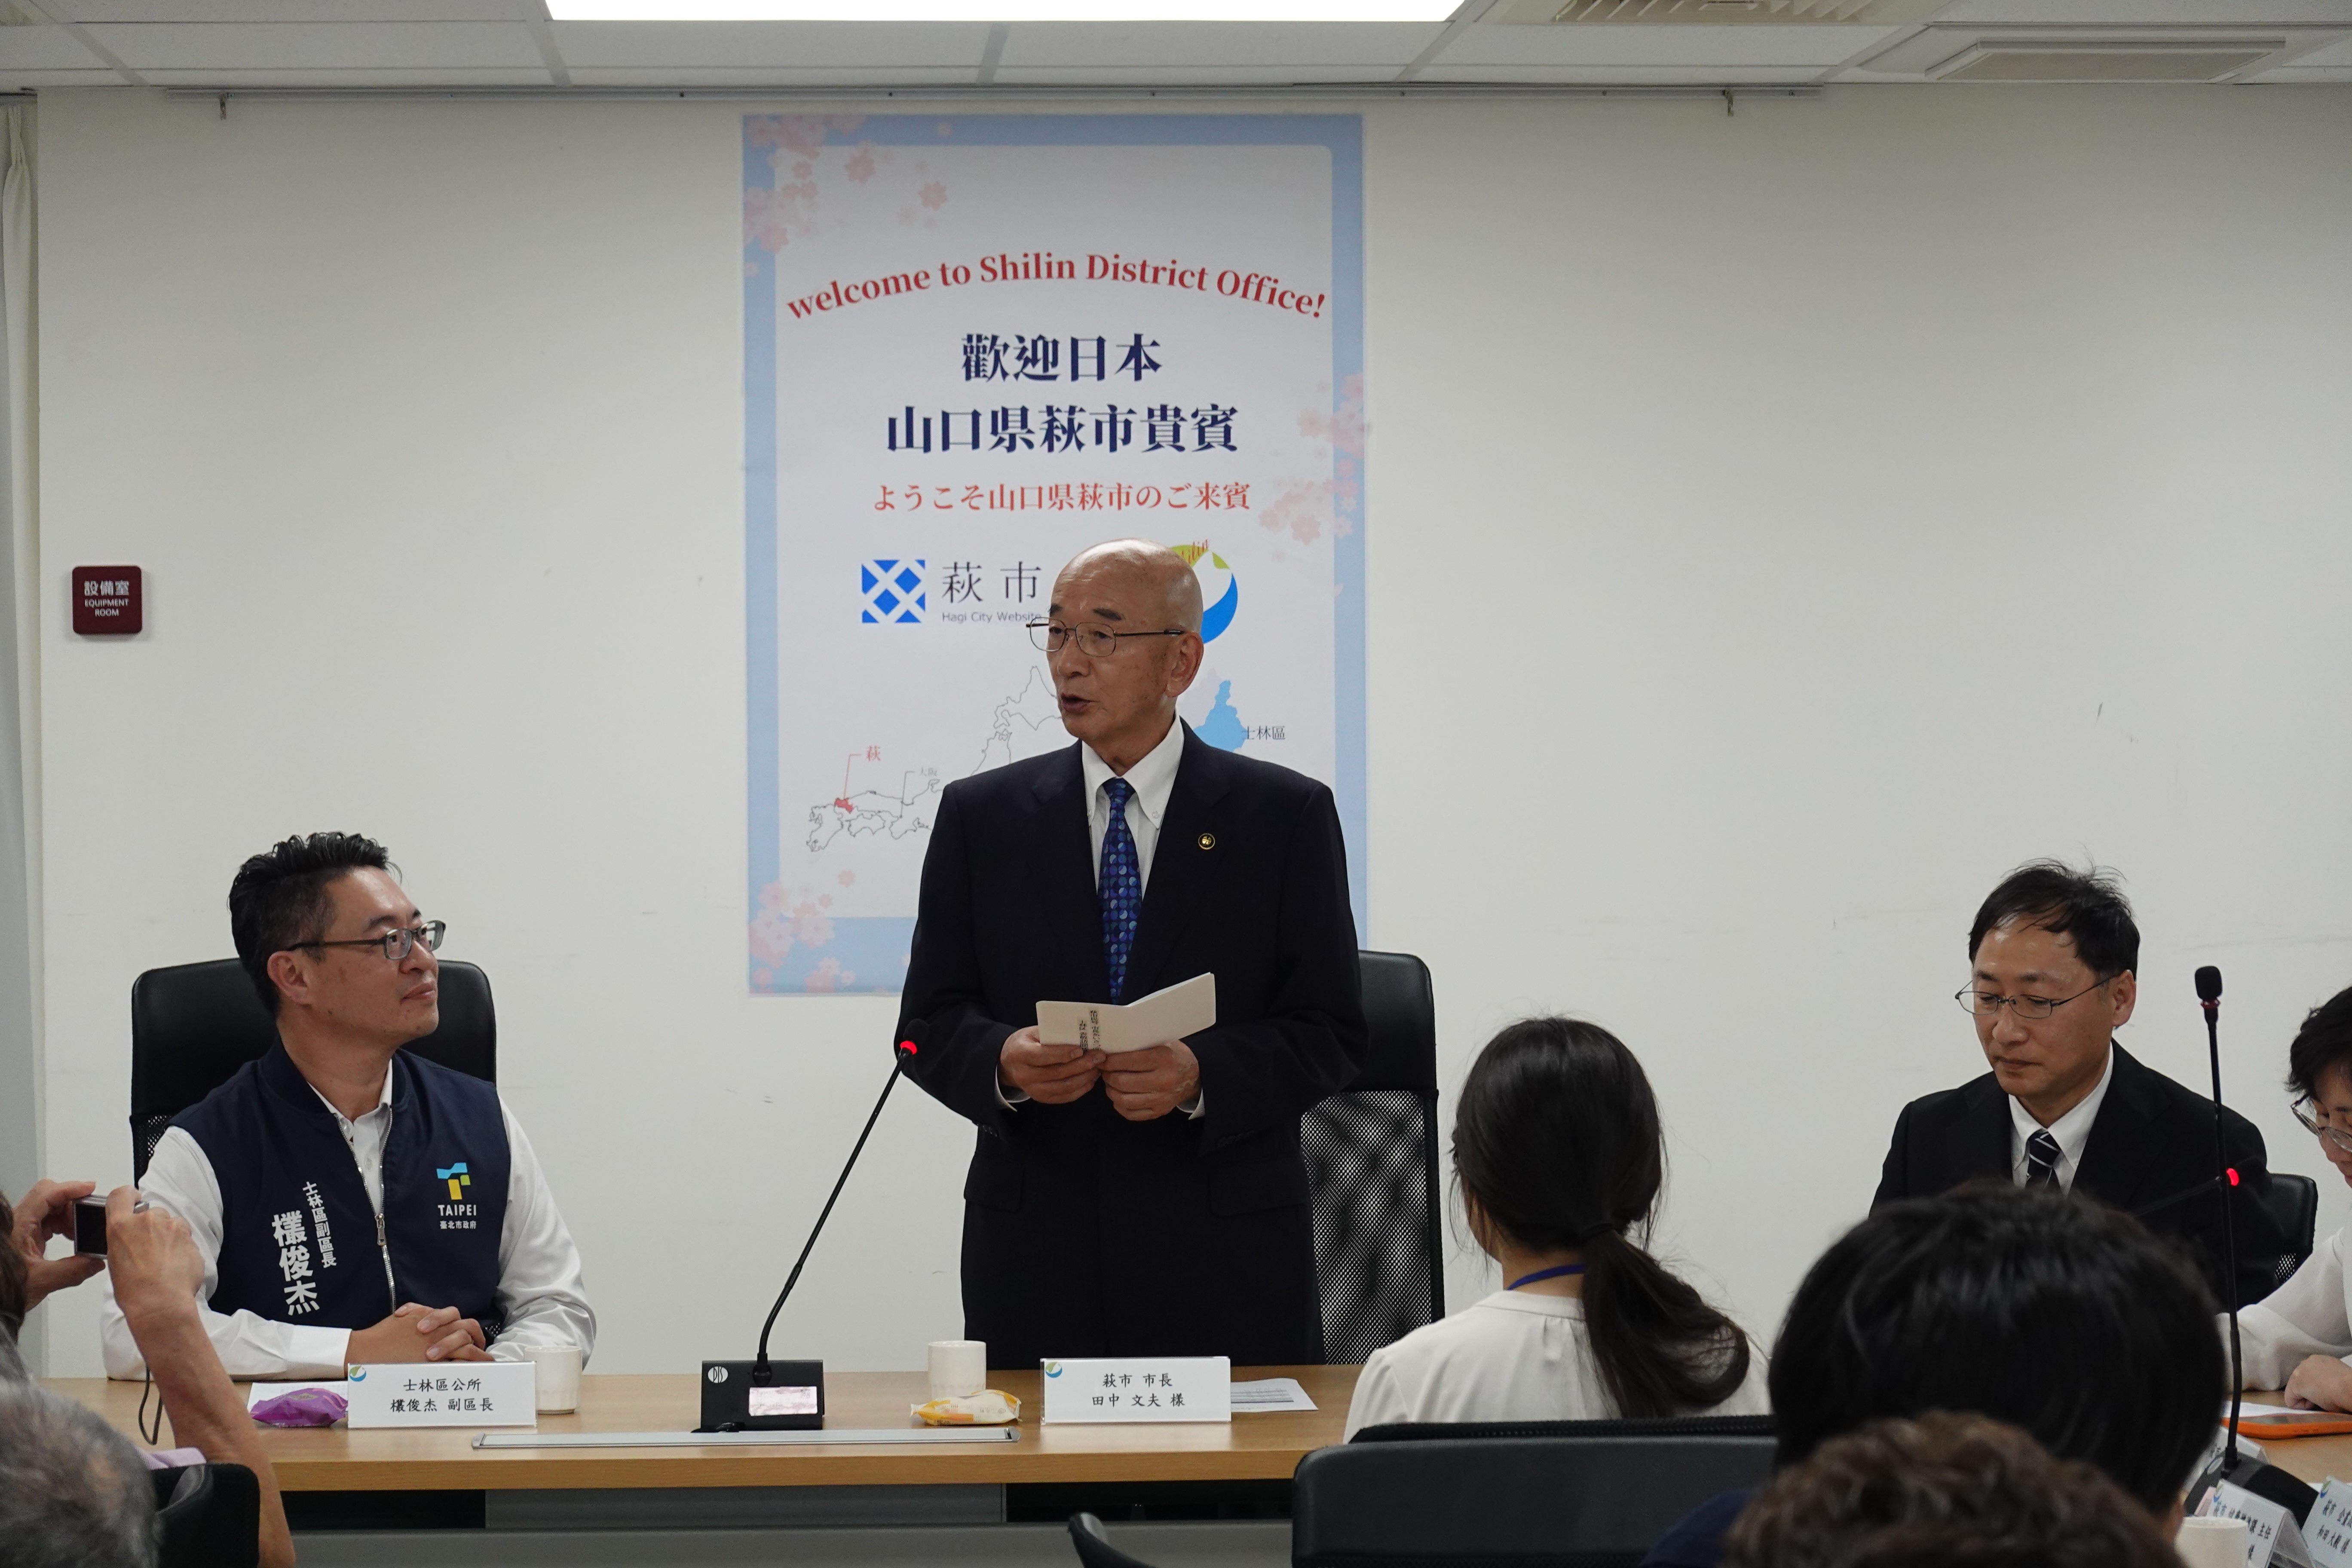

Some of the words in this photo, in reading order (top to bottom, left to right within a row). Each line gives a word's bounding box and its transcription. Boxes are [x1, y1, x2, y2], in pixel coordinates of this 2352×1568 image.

[787, 270, 931, 319] welcome
[940, 263, 971, 286] to
[980, 252, 1076, 282] Shilin
[1087, 254, 1208, 291] District
[1216, 270, 1325, 318] Office!
[962, 333, 1162, 382] 歡迎日本
[887, 403, 1238, 453] 山口県萩市貴賓
[874, 481, 1250, 511] ようこそ山口県萩市のご来賓
[84, 580, 129, 596] 設備室
[84, 598, 129, 608] EQUIPMENT
[95, 608, 119, 617] ROOM
[942, 612, 967, 623] Hagi
[971, 612, 992, 623] City
[1241, 725, 1285, 740] 士林區
[866, 745, 881, 761] 萩
[438, 1204, 477, 1216] TAIPEI
[303, 1181, 337, 1268] 士林區副區長
[440, 1220, 477, 1229] 臺北市政府
[403, 1378, 481, 1392] 士林區公所
[1102, 1373, 1132, 1388] 萩市
[1142, 1373, 1173, 1387] 市長
[447, 1397, 494, 1412] 副區長
[1092, 1393, 1120, 1408] 田中
[1131, 1393, 1161, 1407] 文夫
